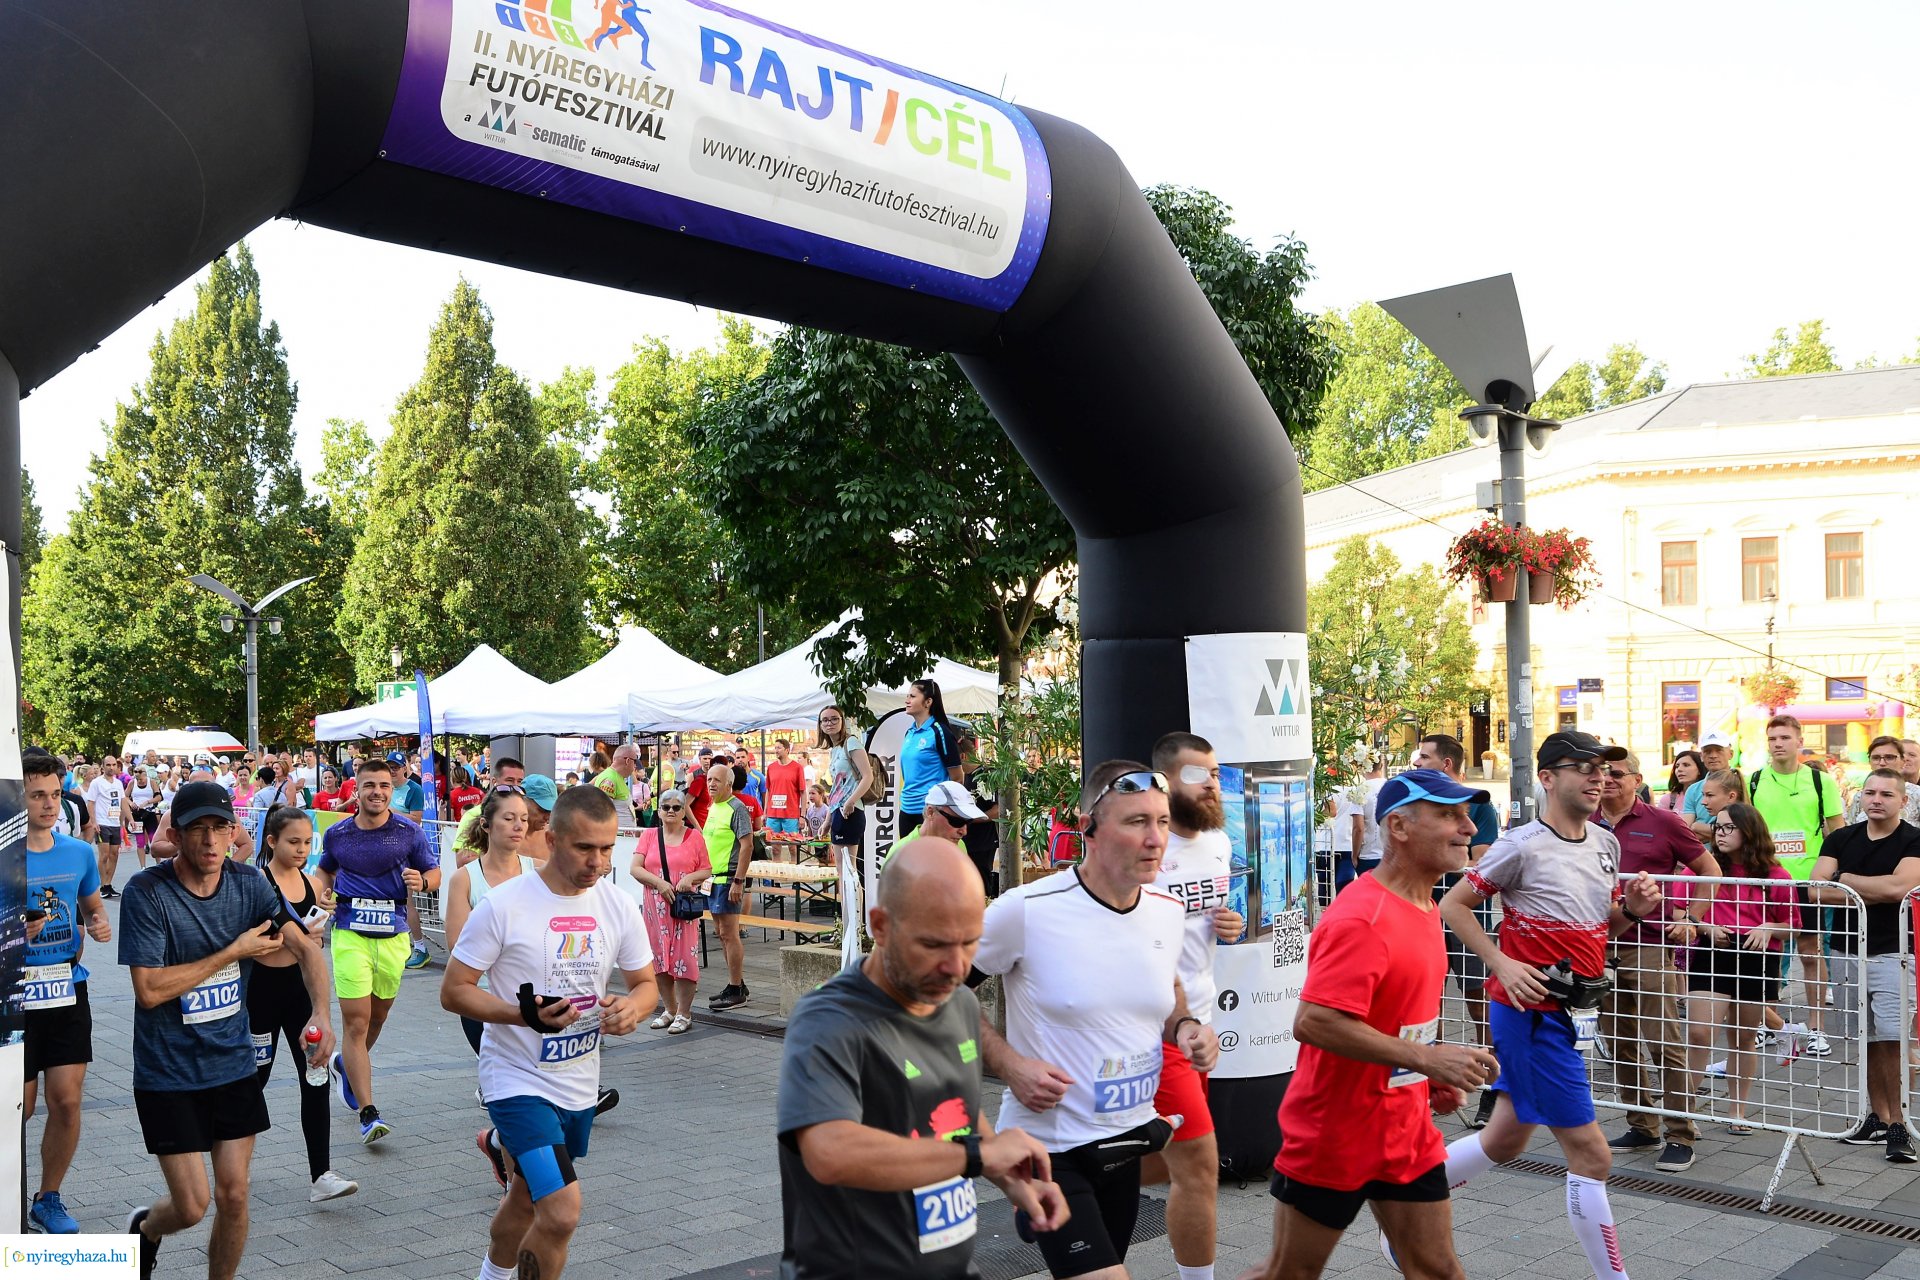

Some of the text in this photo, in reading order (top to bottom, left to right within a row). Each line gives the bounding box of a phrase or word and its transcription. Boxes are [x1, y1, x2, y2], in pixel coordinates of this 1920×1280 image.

[473, 30, 675, 111] II. NYÍREGYHÁZI
[469, 62, 667, 141] FUTÓFESZTIVÁL
[699, 25, 1012, 182] RAJT/CÉL
[484, 132, 506, 145] WITTUR
[532, 126, 587, 153] sematic
[591, 146, 660, 173] támogatásával
[702, 136, 1000, 241] www.nyiregyhazifutofesztival.hu
[1272, 725, 1300, 737] WITTUR
[355, 910, 391, 924] 21116
[25, 981, 70, 1001] 21107
[187, 983, 239, 1011] 21102
[1252, 991, 1283, 1004] Wittur
[546, 1032, 596, 1060] 21048
